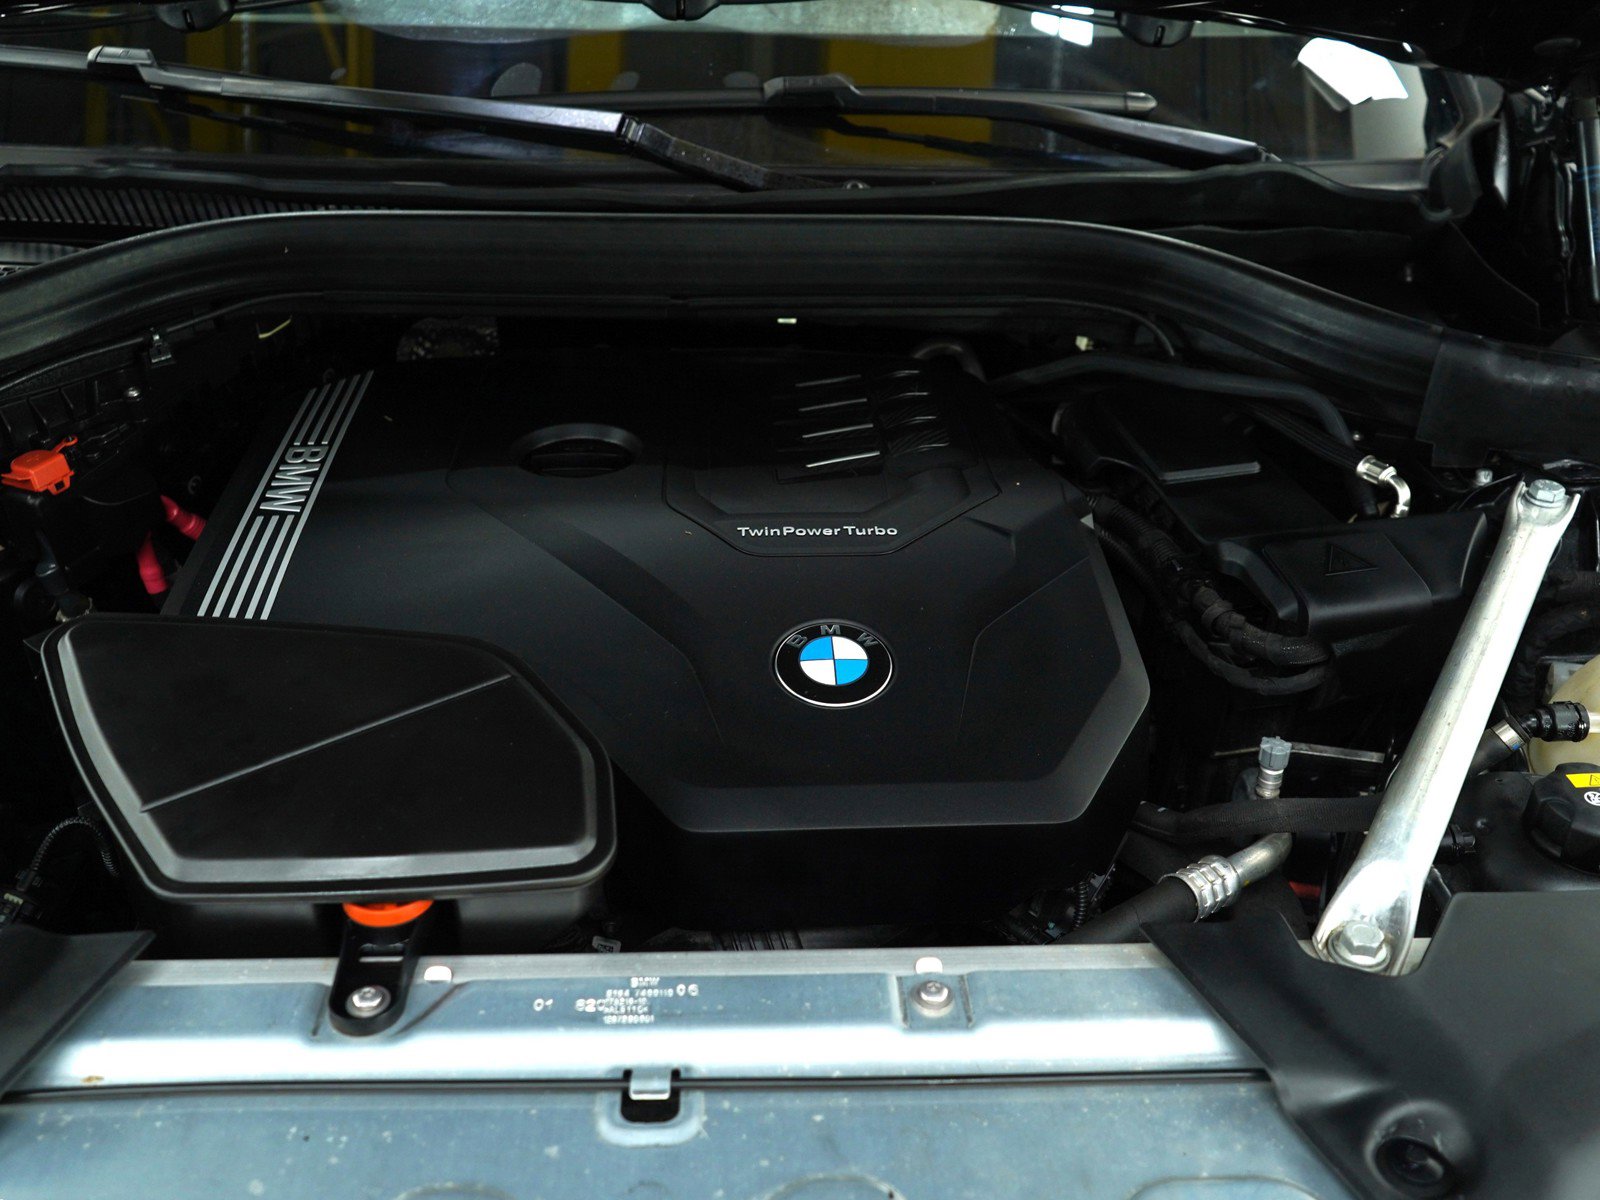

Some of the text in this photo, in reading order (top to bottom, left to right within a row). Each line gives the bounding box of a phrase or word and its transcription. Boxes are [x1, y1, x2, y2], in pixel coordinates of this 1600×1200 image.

[259, 446, 329, 513] BMW
[843, 525, 898, 536] Turbo
[786, 624, 879, 649] BMW
